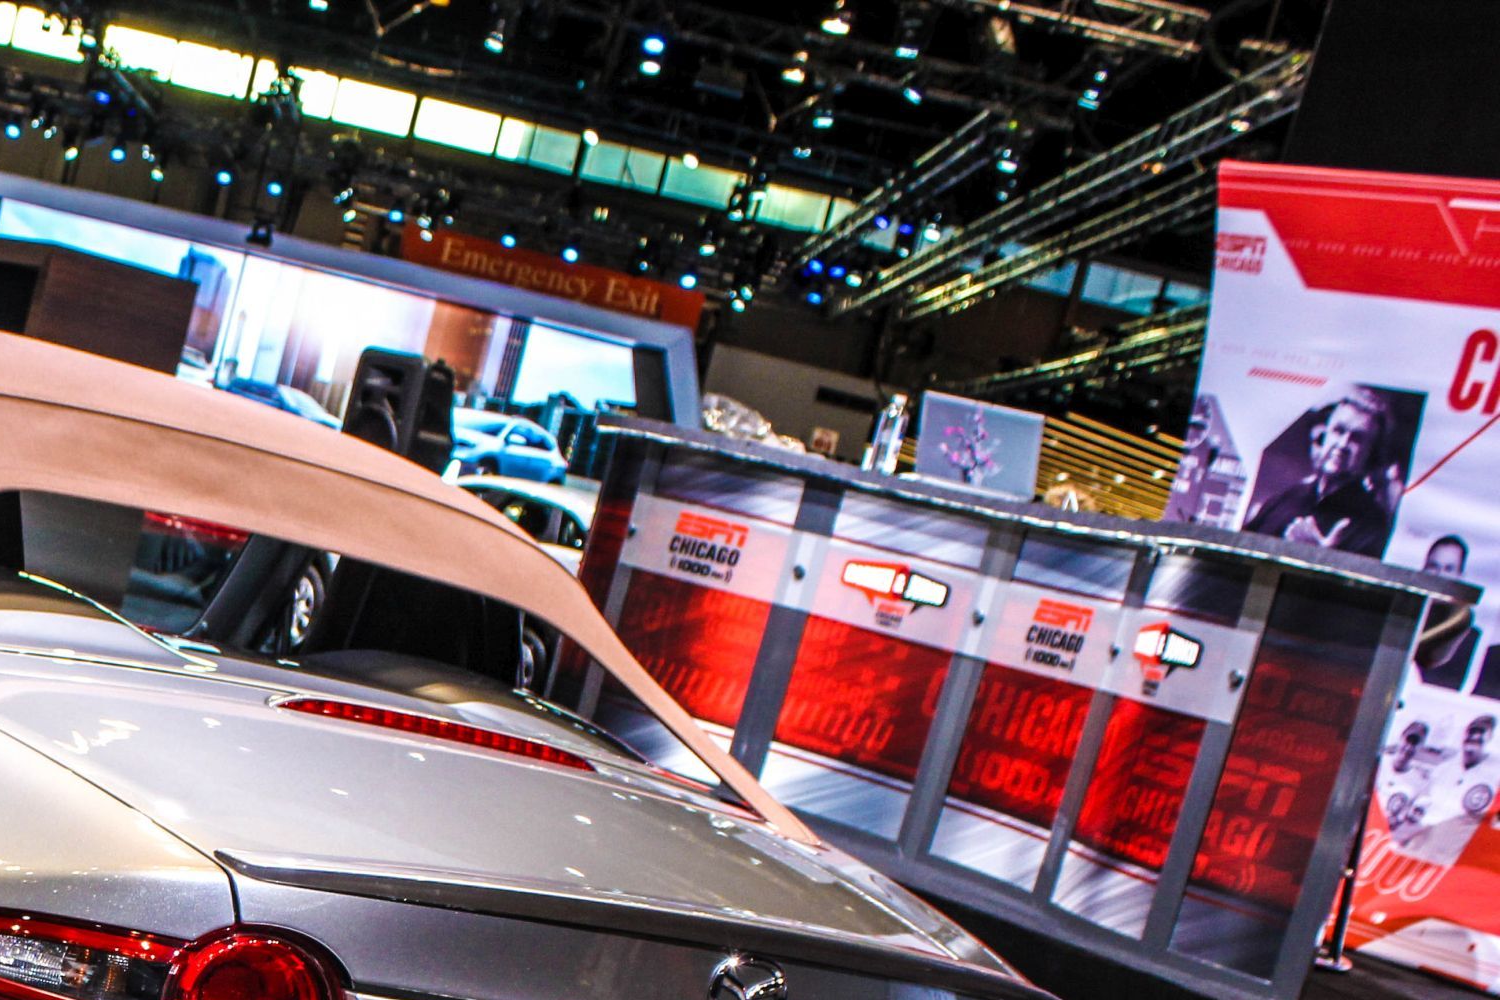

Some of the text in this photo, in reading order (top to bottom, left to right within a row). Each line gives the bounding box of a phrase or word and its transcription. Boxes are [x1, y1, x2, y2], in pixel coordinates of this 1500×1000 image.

[441, 237, 661, 315] Emergency Exit
[1447, 327, 1500, 416] C
[674, 511, 750, 548] ESPN
[668, 535, 741, 567] CHICAGO
[1032, 598, 1095, 632] ESPN
[1026, 624, 1084, 654] CHICAGO
